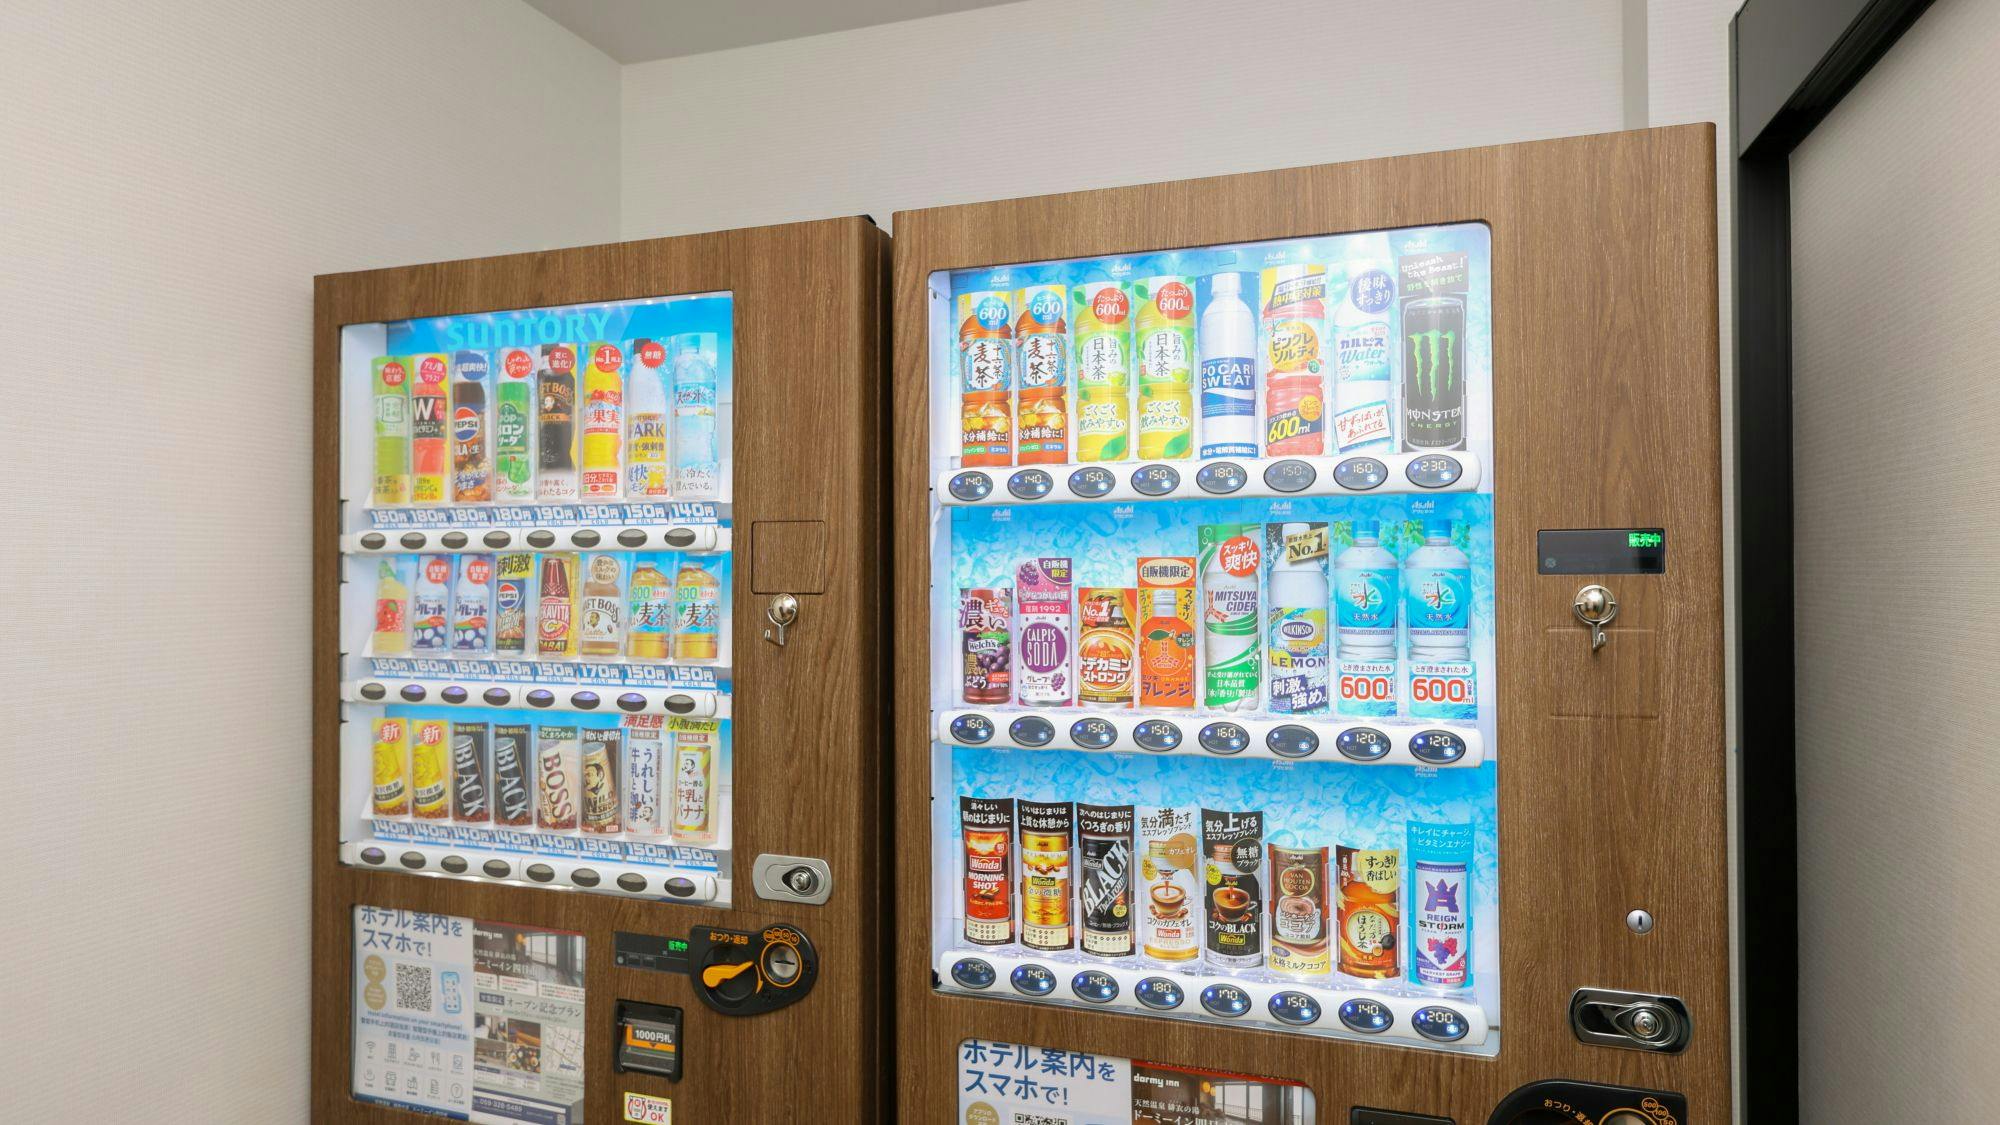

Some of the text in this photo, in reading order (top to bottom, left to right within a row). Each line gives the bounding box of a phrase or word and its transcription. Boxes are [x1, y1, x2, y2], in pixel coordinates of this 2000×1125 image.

[1358, 276, 1386, 291] 後味
[1357, 291, 1391, 306] すっきり
[980, 308, 1006, 320] 600
[1033, 304, 1060, 315] 600
[447, 312, 612, 350] SUNTORY
[1108, 337, 1118, 364] 旨みの
[1172, 334, 1183, 360] 旨みの
[1340, 338, 1384, 350] カルピス
[1028, 337, 1048, 384] 麦茶
[1092, 337, 1106, 380] 日本茶
[1156, 334, 1170, 376] 日本茶
[1274, 347, 1314, 364] ソルティ
[1340, 348, 1386, 364] Water
[974, 342, 995, 388] 麦茶
[1202, 364, 1254, 378] POCARI
[1202, 375, 1250, 388] SWEAT
[414, 398, 434, 420] W
[1085, 404, 1117, 417] ごくごく
[1147, 401, 1180, 414] ごくごく
[1406, 407, 1462, 421] MONSTER
[1080, 418, 1125, 430] 飲みやすい
[1140, 416, 1188, 429] 飲みやすい
[1268, 416, 1310, 443] 600ml
[1282, 466, 1302, 476] 150
[1353, 464, 1373, 474] 160
[1420, 460, 1446, 471] 230
[1024, 474, 1042, 484] 140
[1086, 472, 1104, 482] 150
[1150, 469, 1167, 479] 150
[1214, 468, 1234, 478] 180
[966, 476, 982, 486] 140
[410, 509, 446, 522] 180円
[449, 508, 488, 522] 180円
[492, 506, 532, 520] 180円
[534, 506, 574, 520] 190円
[578, 504, 620, 519] 190円
[623, 504, 665, 518] 150円
[671, 502, 715, 518] 140円
[1288, 534, 1327, 560] No.1
[1629, 533, 1661, 548] 販売中
[1224, 540, 1252, 556] スッキリ
[1224, 551, 1258, 572] 爽快
[1141, 566, 1190, 578] 自販機限定
[632, 587, 650, 600] 600
[678, 587, 697, 600] 600
[1215, 590, 1257, 601] MITSUYA
[1082, 600, 1110, 617] No.1
[1226, 602, 1257, 612] CIDER
[639, 602, 672, 627] 麦茶
[686, 602, 718, 627] 麦茶
[959, 600, 1005, 628] 濃い
[1354, 613, 1379, 621] 天然水
[1426, 613, 1454, 621] 天然水
[1027, 628, 1056, 642] CALPIS
[1282, 624, 1314, 635] WILKINSON
[969, 640, 996, 650] Welch's
[1027, 642, 1058, 666] SODA
[373, 659, 408, 672] 160円
[412, 660, 449, 672] 160円
[452, 661, 490, 674] 160円
[493, 662, 530, 675] 150円
[966, 654, 988, 675] 濃い
[1080, 657, 1131, 672] ドデカミン
[1271, 656, 1326, 668] LEMON
[535, 663, 574, 676] 150円
[579, 665, 620, 678] 170円
[623, 666, 665, 680] 150円
[671, 666, 714, 681] 150円
[965, 676, 986, 688] ぶどう
[1083, 671, 1126, 684] ストロング
[1292, 688, 1327, 710] 強め。
[623, 714, 664, 728] 満足感
[670, 716, 717, 732] 小腹満たし
[966, 720, 984, 728] 160
[381, 725, 398, 741] 新
[1088, 723, 1106, 733] 150
[1152, 725, 1170, 735] 150
[1217, 728, 1236, 738] 160
[423, 727, 439, 743] 新
[1356, 734, 1376, 743] 120
[1430, 736, 1450, 746] 120
[455, 746, 485, 816] BLACK
[641, 748, 654, 805] うれしい
[496, 748, 528, 820] BLACK
[543, 752, 572, 818] BOSS
[1022, 805, 1067, 814] いいはじまりは
[962, 811, 1010, 824] 朝のはじまりに
[1020, 815, 1070, 828] 上質な休憩から
[1141, 808, 1192, 828] 気分満たす
[1206, 812, 1257, 833] 気分上げる
[373, 820, 408, 834] 140円
[413, 823, 448, 836] 140円
[1080, 820, 1130, 833] くつろぎの香り
[1142, 822, 1192, 836] エスプレッソブレンド
[451, 827, 488, 840] 140円
[493, 830, 529, 844] 140円
[1206, 829, 1258, 840] エスプレッソブレンド
[536, 834, 575, 849] 140円
[580, 838, 620, 853] 130円
[1418, 838, 1472, 848] ビタミンエナジー
[625, 842, 667, 858] 150円
[672, 847, 714, 862] 150円
[1237, 846, 1258, 859] 無糖
[971, 861, 1000, 870] Wonda
[1237, 859, 1259, 867] ブラック
[1366, 856, 1397, 868] すっきり
[968, 872, 1004, 881] MORNING
[1083, 840, 1129, 918] BLACK
[1366, 870, 1397, 882] 香ばしい
[973, 881, 997, 890] SHOT
[1427, 914, 1457, 922] REIGN
[1209, 921, 1256, 933] コクのBLACK
[1280, 920, 1315, 933] ココア
[1358, 915, 1368, 949] ほうじ茶
[1419, 921, 1464, 931] STORM
[363, 929, 432, 957] スマホで!
[1272, 958, 1326, 970] 本格ミルクココア
[1028, 970, 1044, 979] 140
[1090, 977, 1106, 986] 140
[1152, 983, 1171, 993] 180
[1219, 990, 1238, 1000] 170
[1288, 997, 1307, 1008] 150
[1358, 1004, 1379, 1015] 140
[1427, 1011, 1453, 1023] 200
[635, 1029, 672, 1043] 1000円札
[964, 1040, 1116, 1082] ホテル案内を
[965, 1069, 1068, 1105] スマホで!
[1134, 1073, 1164, 1088] dormy
[1134, 1098, 1166, 1110] 天然温泉
[651, 1112, 664, 1122] OK
